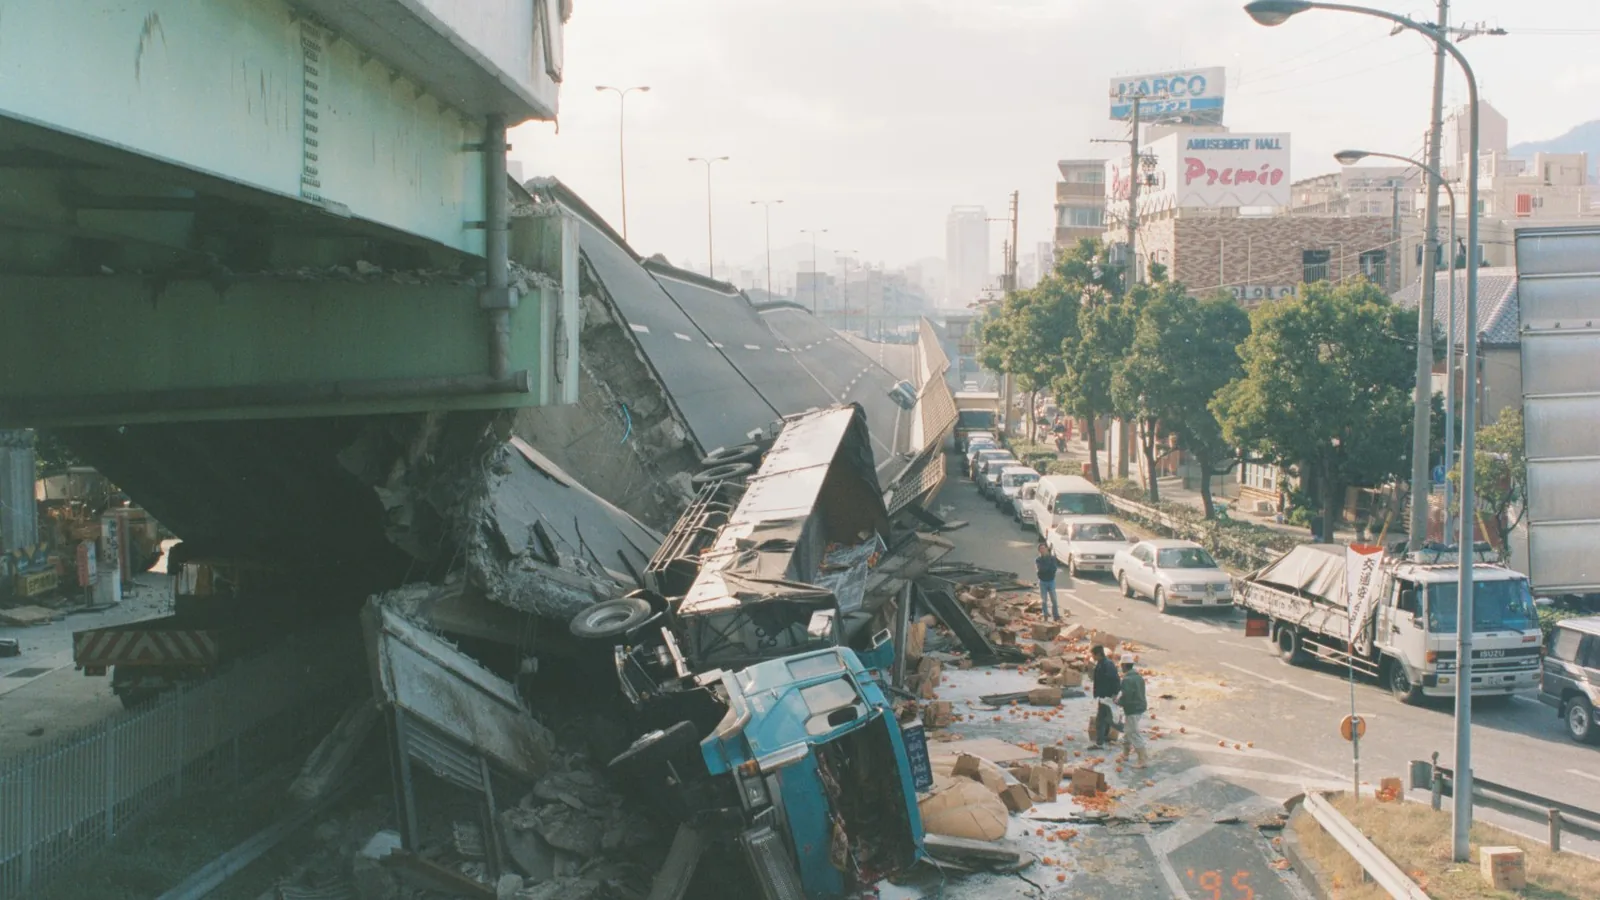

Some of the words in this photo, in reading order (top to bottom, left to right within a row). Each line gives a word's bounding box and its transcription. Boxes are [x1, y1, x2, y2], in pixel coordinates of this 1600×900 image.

[1186, 138, 1251, 150] AMUSEMENT
[1255, 138, 1283, 150] HALL
[1184, 157, 1284, 186] Premio
[1480, 649, 1505, 659] ISUZU
